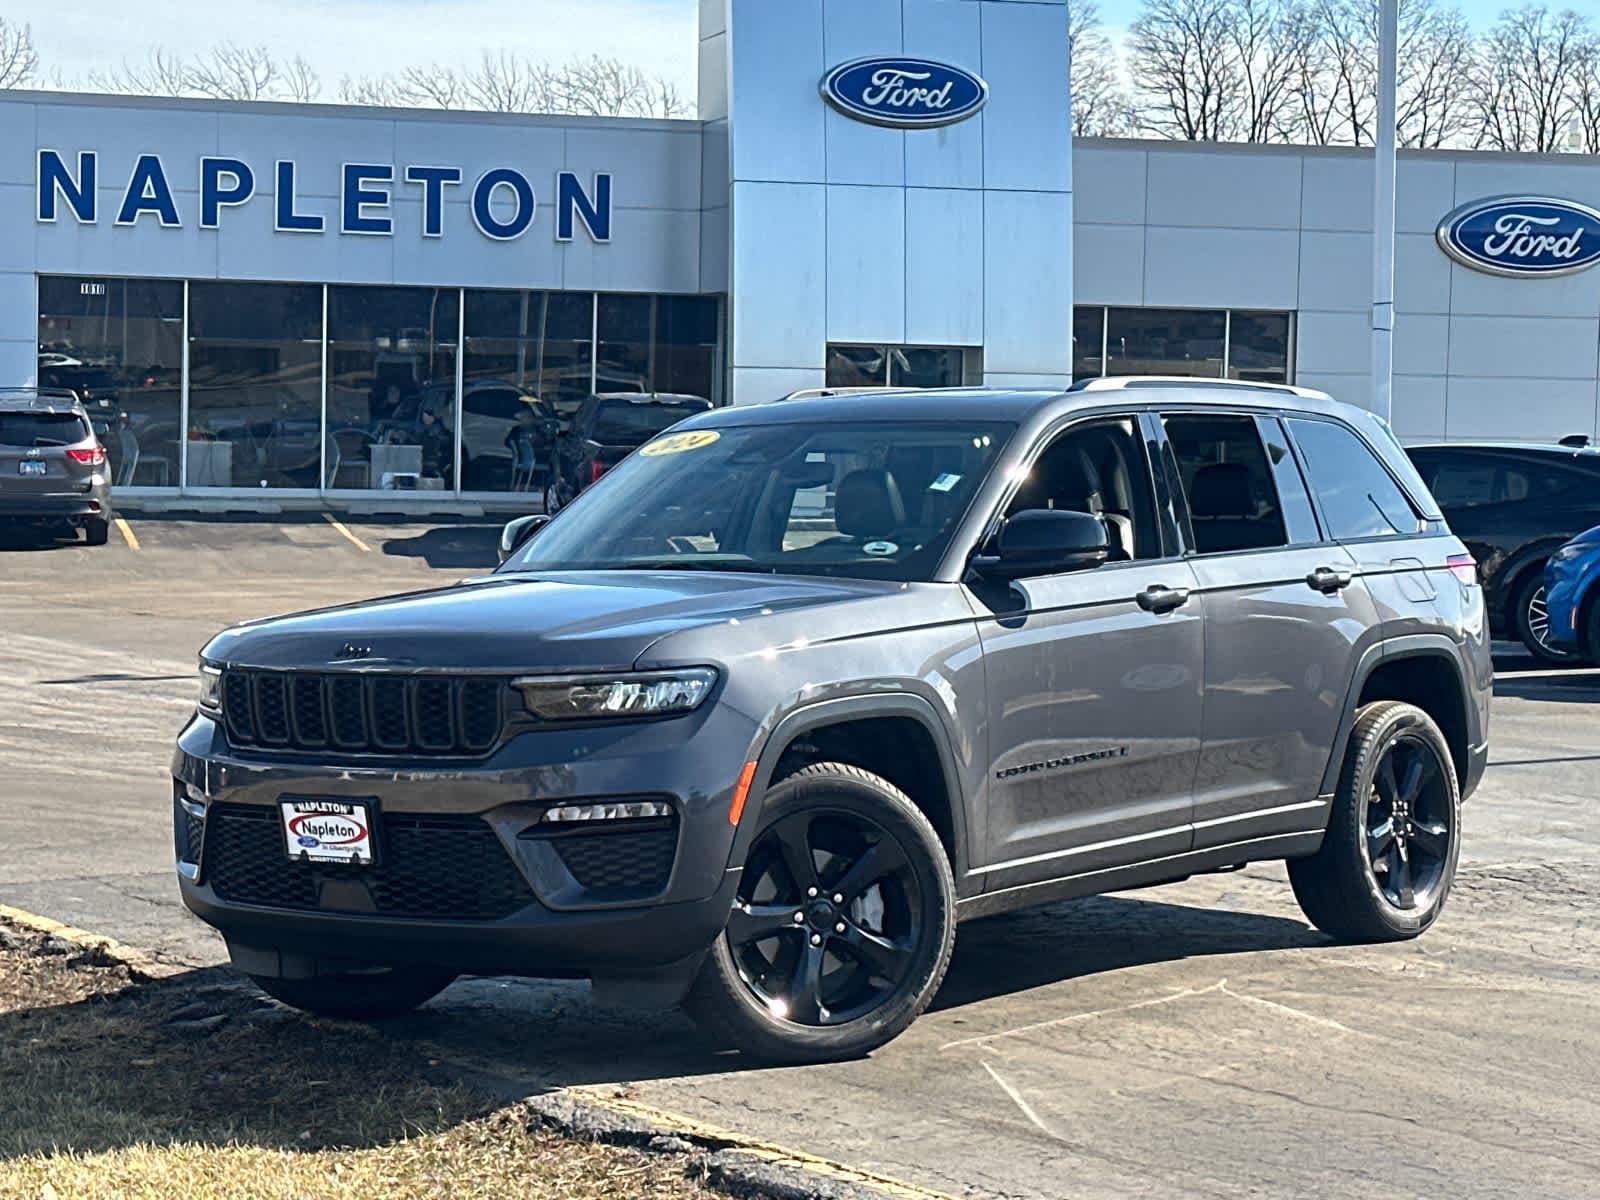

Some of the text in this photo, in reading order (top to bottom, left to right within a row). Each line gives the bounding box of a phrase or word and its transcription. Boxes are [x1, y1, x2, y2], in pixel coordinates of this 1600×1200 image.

[862, 68, 953, 108] Ford
[36, 149, 612, 242] NAPLETON
[1484, 214, 1585, 258] Ford
[301, 821, 355, 839] Napleton
